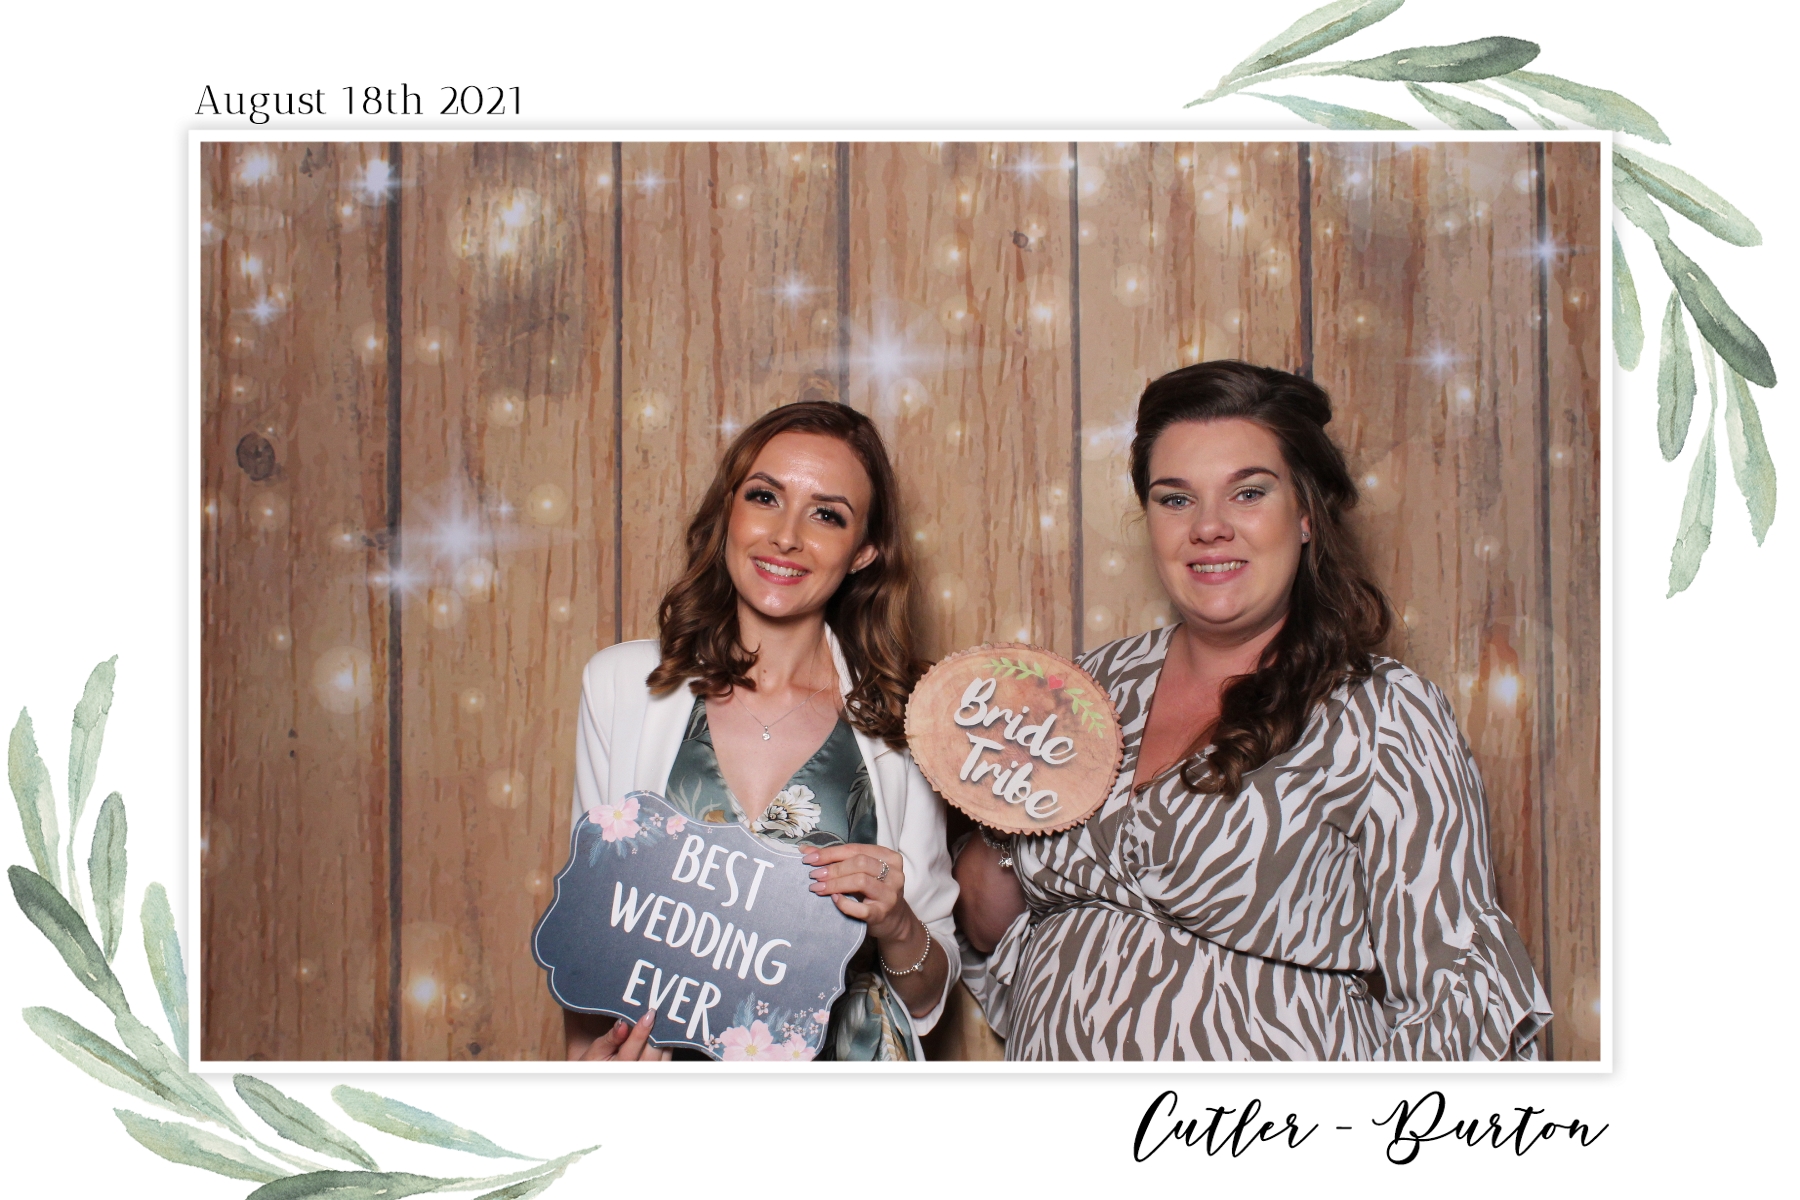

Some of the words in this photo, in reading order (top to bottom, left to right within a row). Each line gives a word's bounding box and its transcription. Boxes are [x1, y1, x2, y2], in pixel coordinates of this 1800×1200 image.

[953, 677, 1078, 765] Bride
[959, 731, 1063, 819] Tribe
[672, 835, 774, 911] BEST
[610, 881, 792, 985] WEDDING
[622, 959, 722, 1041] EVER
